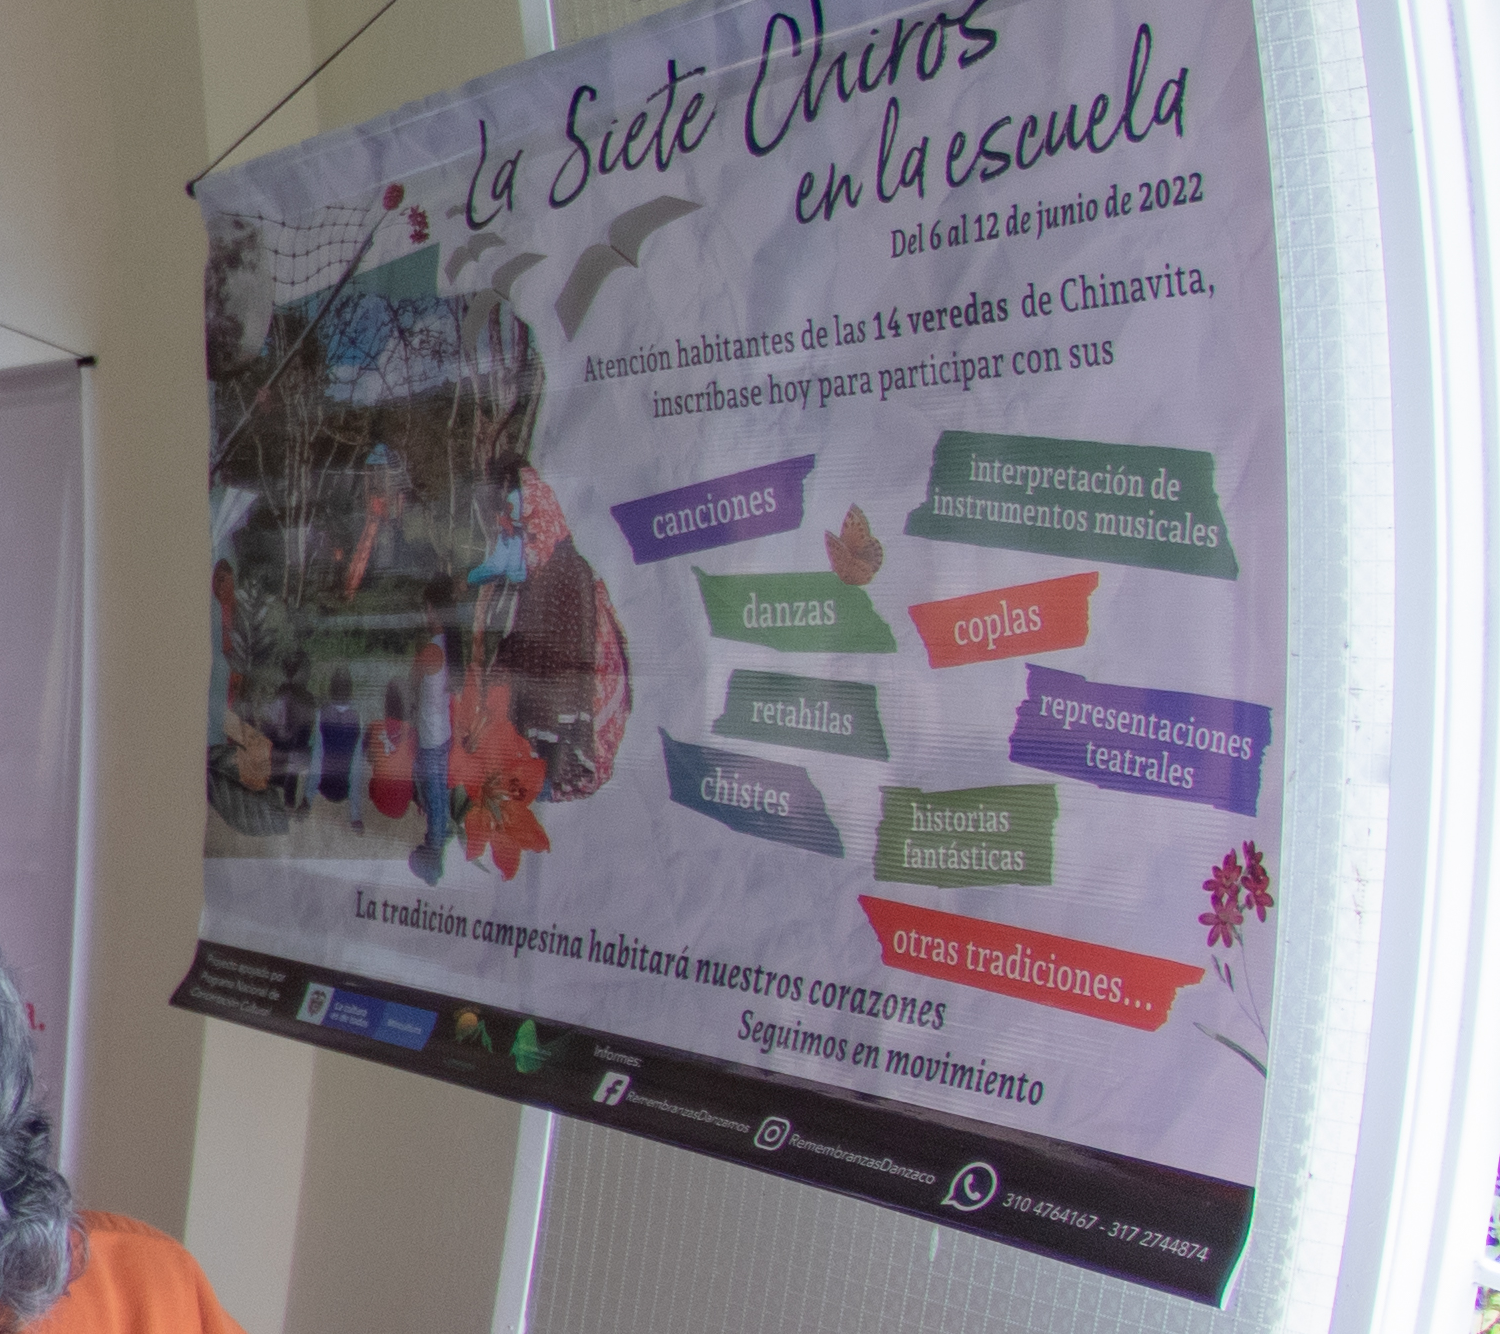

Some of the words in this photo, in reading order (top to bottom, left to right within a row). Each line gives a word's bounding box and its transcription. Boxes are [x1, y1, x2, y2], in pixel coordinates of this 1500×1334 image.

[466, 119, 524, 232] La
[547, 58, 715, 210] Siete
[796, 161, 862, 225] en
[875, 97, 930, 205] la
[944, 22, 1190, 185] escuela
[890, 226, 927, 259] Del
[929, 223, 945, 251] 6
[946, 217, 970, 247] al
[973, 213, 1001, 244] 12
[1005, 205, 1032, 238] de
[1034, 193, 1099, 240] junio
[1104, 187, 1132, 221] de
[1138, 171, 1205, 213] 2022
[583, 339, 673, 385] Atención
[674, 322, 795, 372] habitantes
[800, 317, 829, 353] de
[833, 313, 867, 348] las
[871, 311, 902, 342] 14
[906, 291, 1010, 336] veredas
[1021, 281, 1052, 320] de
[1059, 262, 1217, 317] Chinavita,
[652, 373, 763, 420] inscríbase
[767, 372, 812, 413] hoy
[818, 369, 874, 406] para
[879, 349, 1005, 402] participar
[1011, 349, 1064, 379] con
[1068, 340, 1115, 372] sus
[969, 453, 1144, 499] interpretación
[1149, 473, 1182, 503] de
[652, 483, 778, 541] canciones
[932, 487, 1088, 535] instrumentos
[1094, 507, 1219, 549] musicales
[742, 593, 836, 629] danzas
[953, 601, 1042, 651] coplas
[751, 695, 854, 737] retahílas
[1039, 693, 1253, 761] representaciones
[700, 769, 792, 817] chistes
[1085, 742, 1195, 790] teatrales
[911, 803, 1010, 834] historias
[901, 839, 1025, 872] fantásticas
[354, 890, 377, 920] La
[381, 898, 467, 938] tradición
[472, 917, 583, 960] campesina
[588, 928, 690, 980] habitará
[695, 957, 804, 1003] nuestros
[808, 979, 947, 1031] corazones
[893, 928, 959, 967] otras
[738, 1009, 848, 1063] Seguimos
[852, 1041, 880, 1070] en
[885, 1048, 1045, 1106] movimiento
[788, 1133, 936, 1185] RemembranzasDanzaco
[1002, 1193, 1032, 1213] 310
[1033, 1202, 1099, 1230] 4764167
[1107, 1222, 1141, 1242] 317
[1138, 1230, 1211, 1263] 2744874
